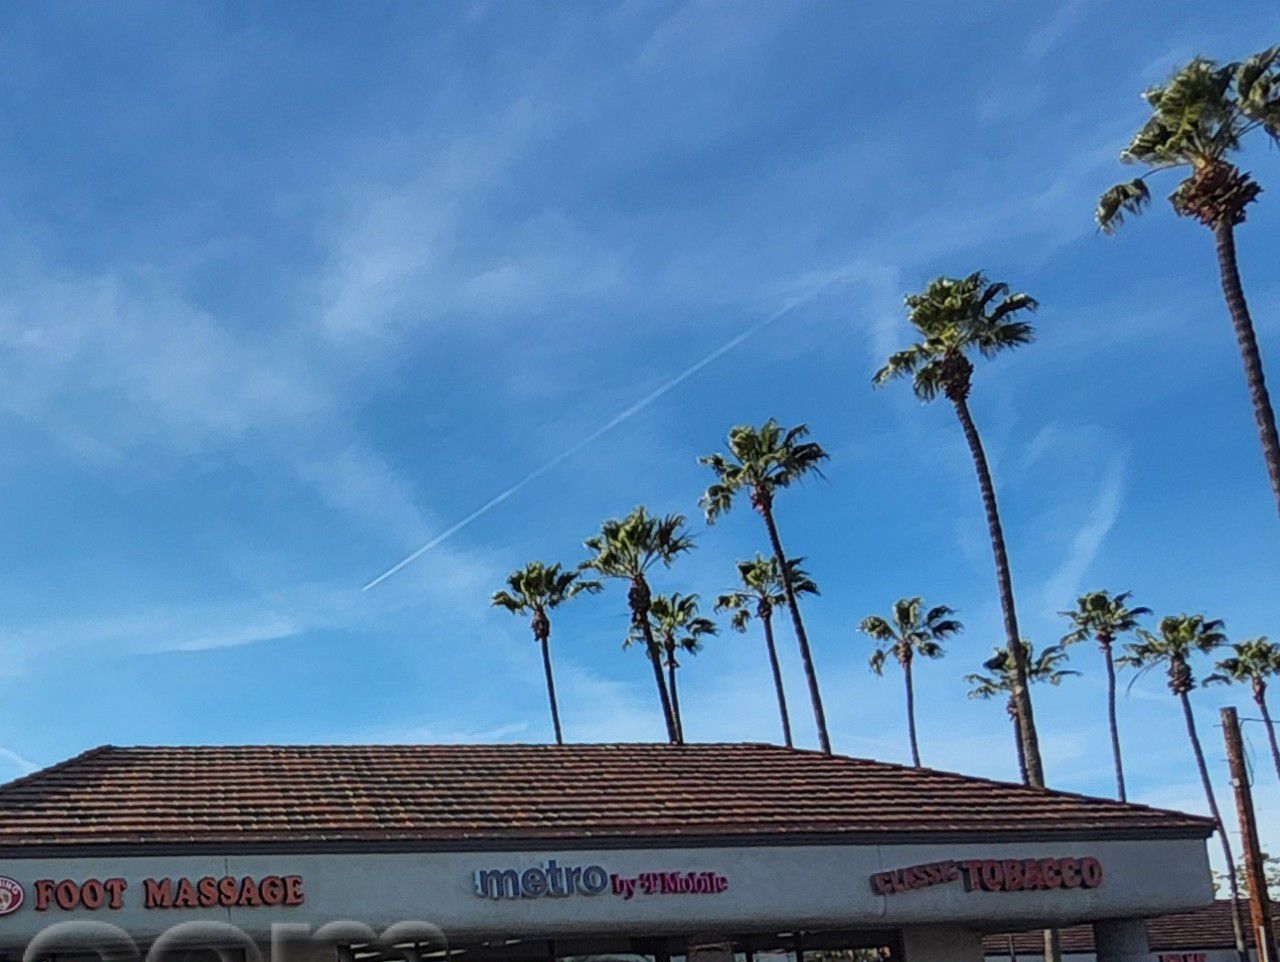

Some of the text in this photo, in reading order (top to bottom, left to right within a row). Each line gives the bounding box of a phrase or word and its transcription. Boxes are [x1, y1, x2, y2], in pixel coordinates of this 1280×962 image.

[35, 875, 305, 911] FOOT MASSAGE
[473, 860, 608, 899] metro
[610, 874, 635, 900] by
[960, 857, 1102, 893] TOBACCO
